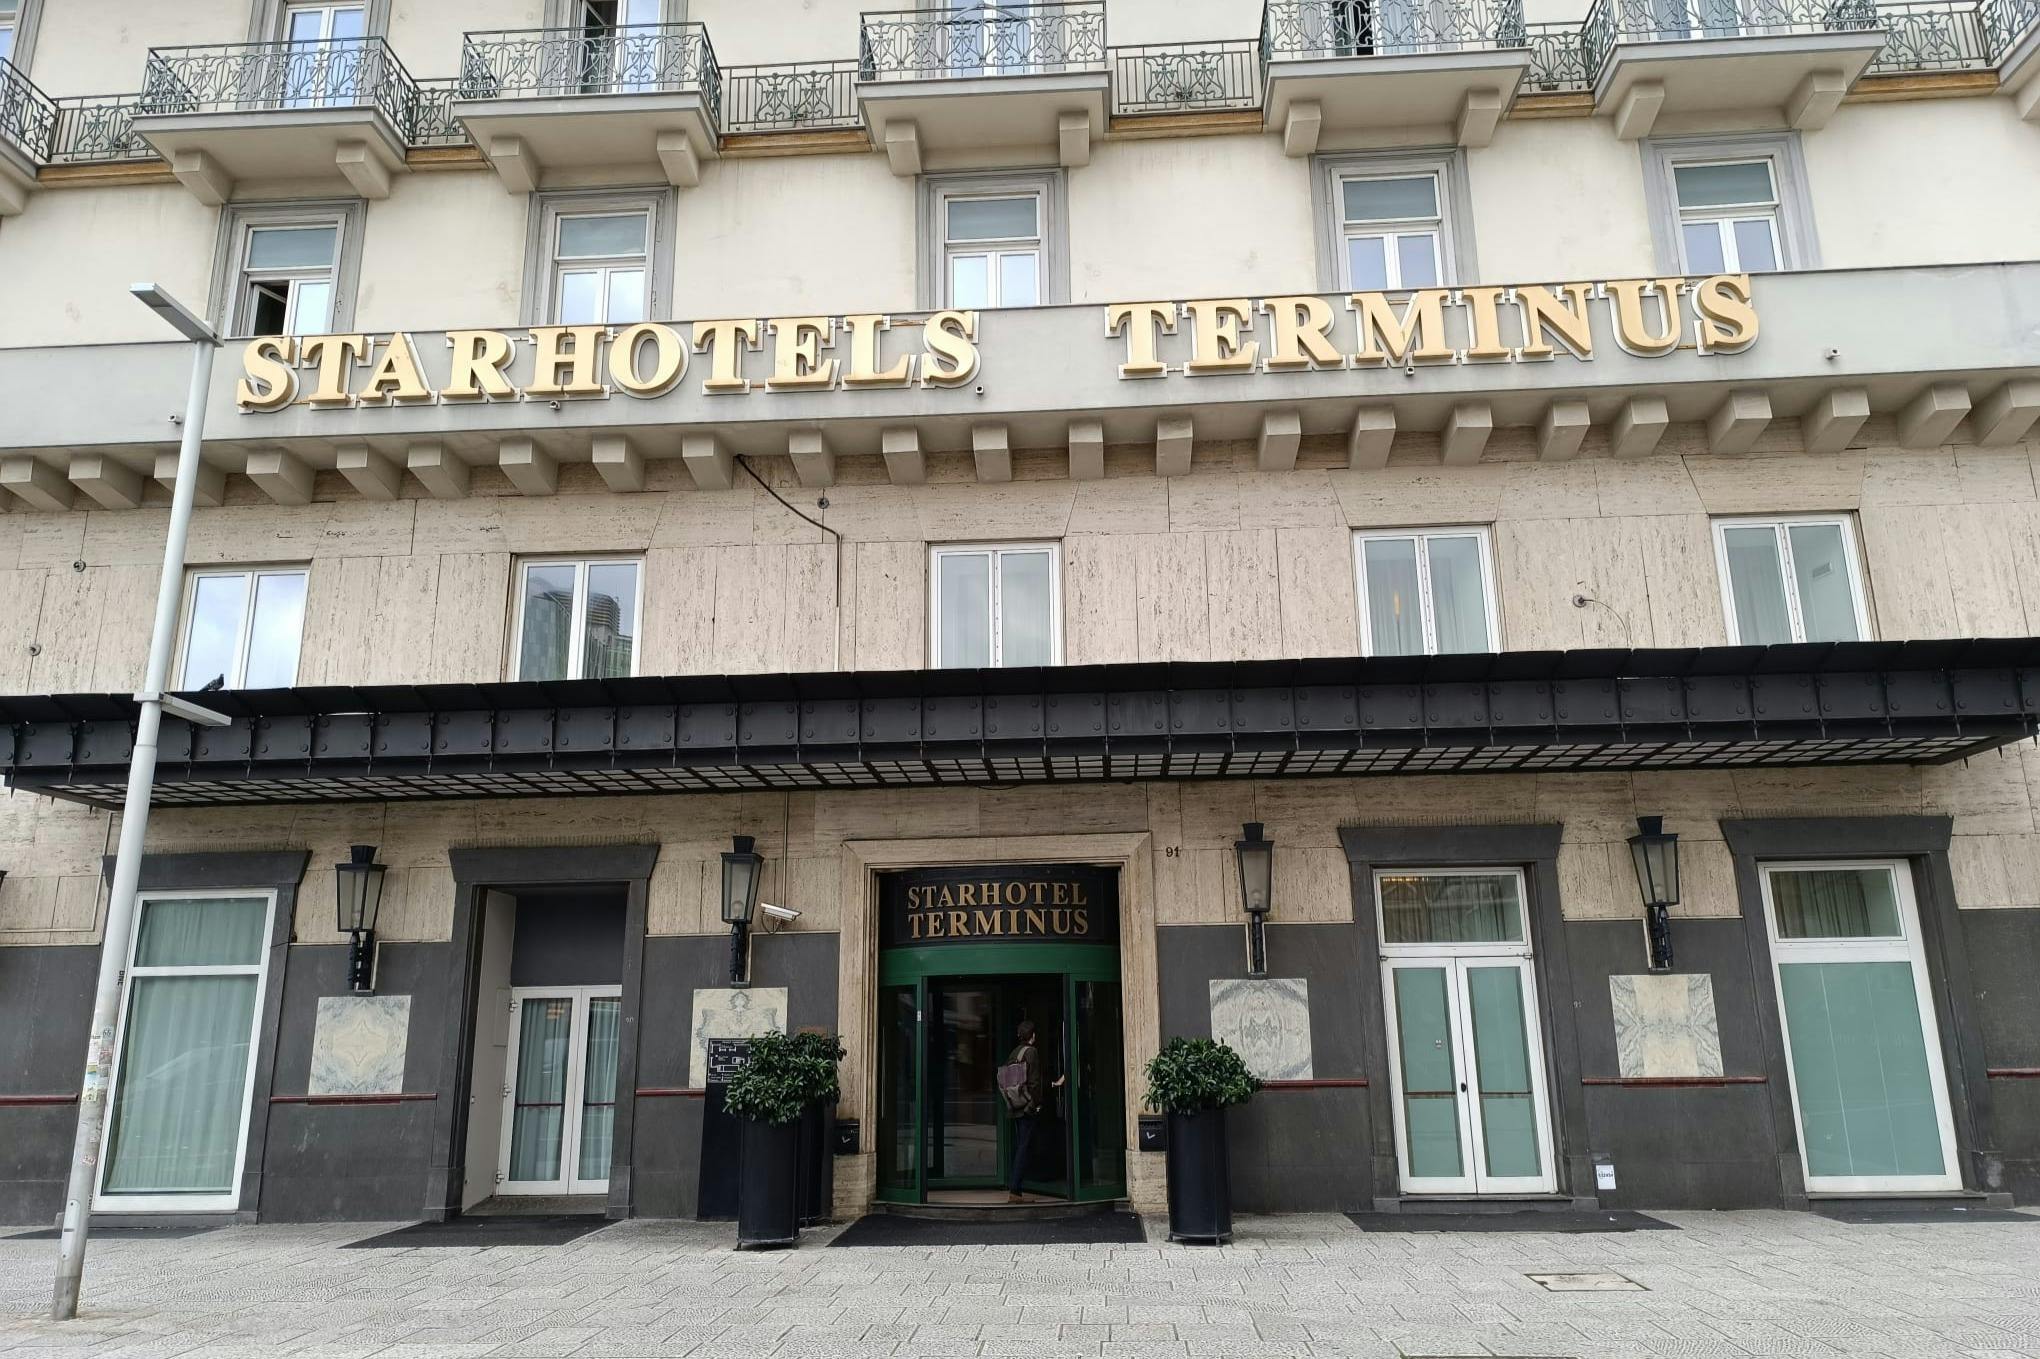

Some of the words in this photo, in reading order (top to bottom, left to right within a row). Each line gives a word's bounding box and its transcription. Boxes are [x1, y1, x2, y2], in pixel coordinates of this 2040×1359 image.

[237, 309, 979, 411] STARHOTELS
[1106, 274, 1760, 377] TERMINUS
[1165, 846, 1179, 858] 91
[907, 882, 1087, 909] STARHOTEL
[907, 909, 1089, 938] TERMINUS
